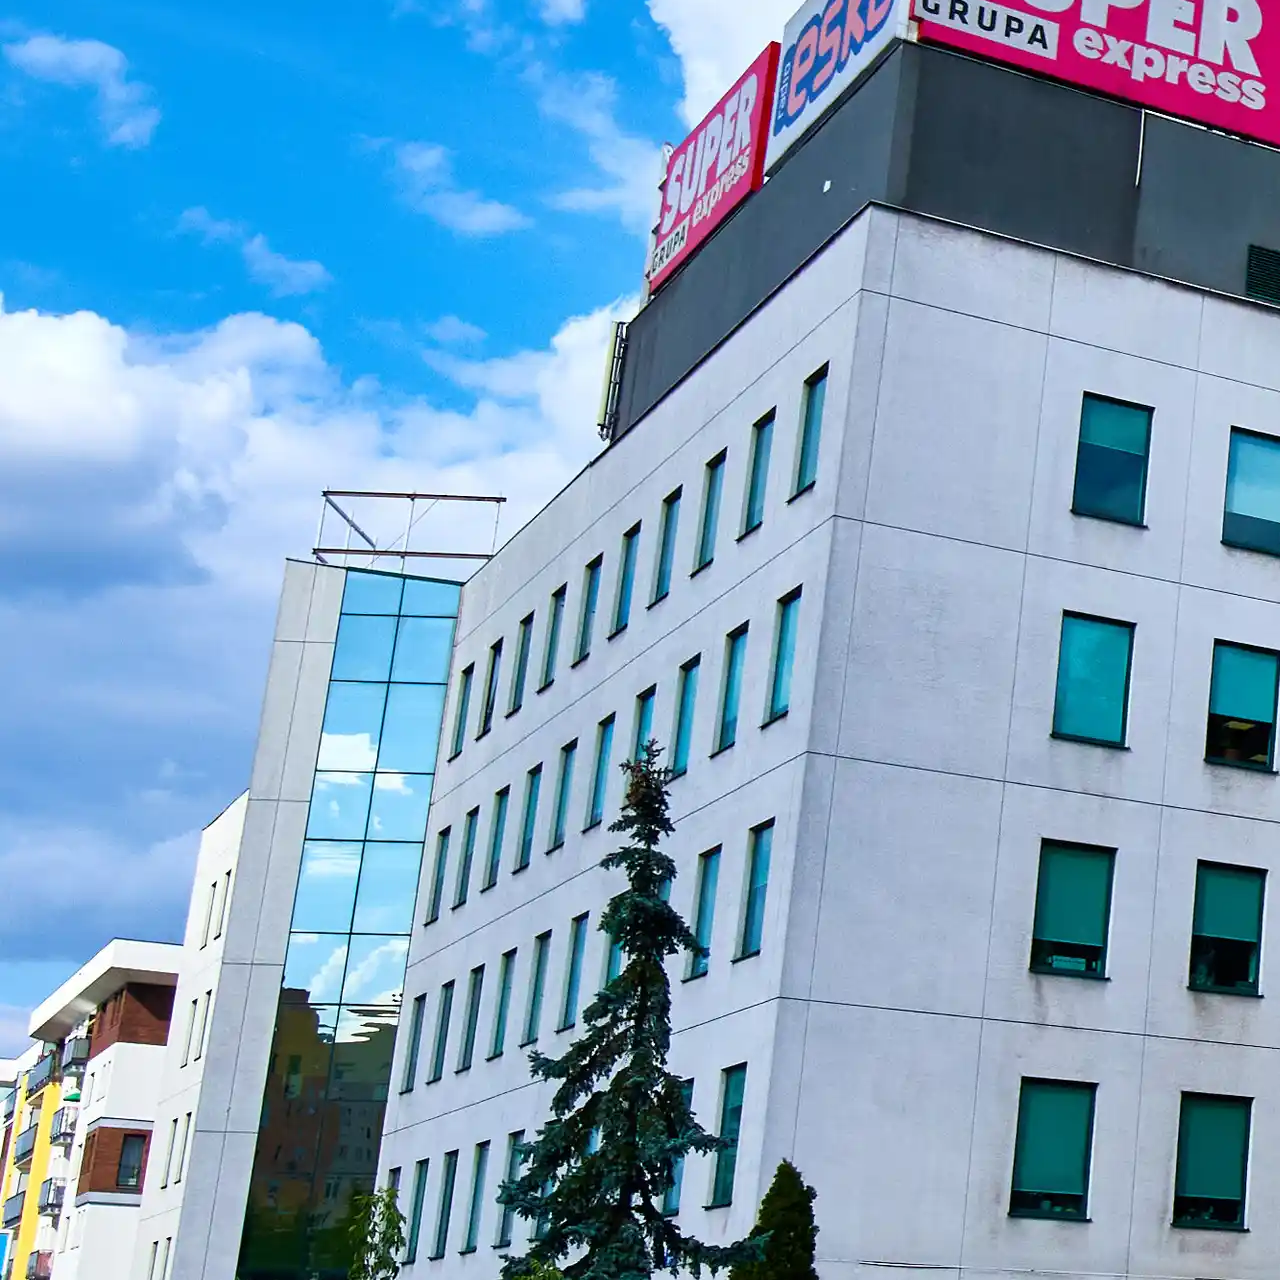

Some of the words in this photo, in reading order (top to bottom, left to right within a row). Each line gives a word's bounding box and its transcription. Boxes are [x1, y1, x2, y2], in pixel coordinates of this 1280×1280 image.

[1072, 27, 1266, 110] express
[660, 73, 757, 235] SUPER
[692, 148, 751, 228] express
[651, 223, 686, 272] GRUPA
